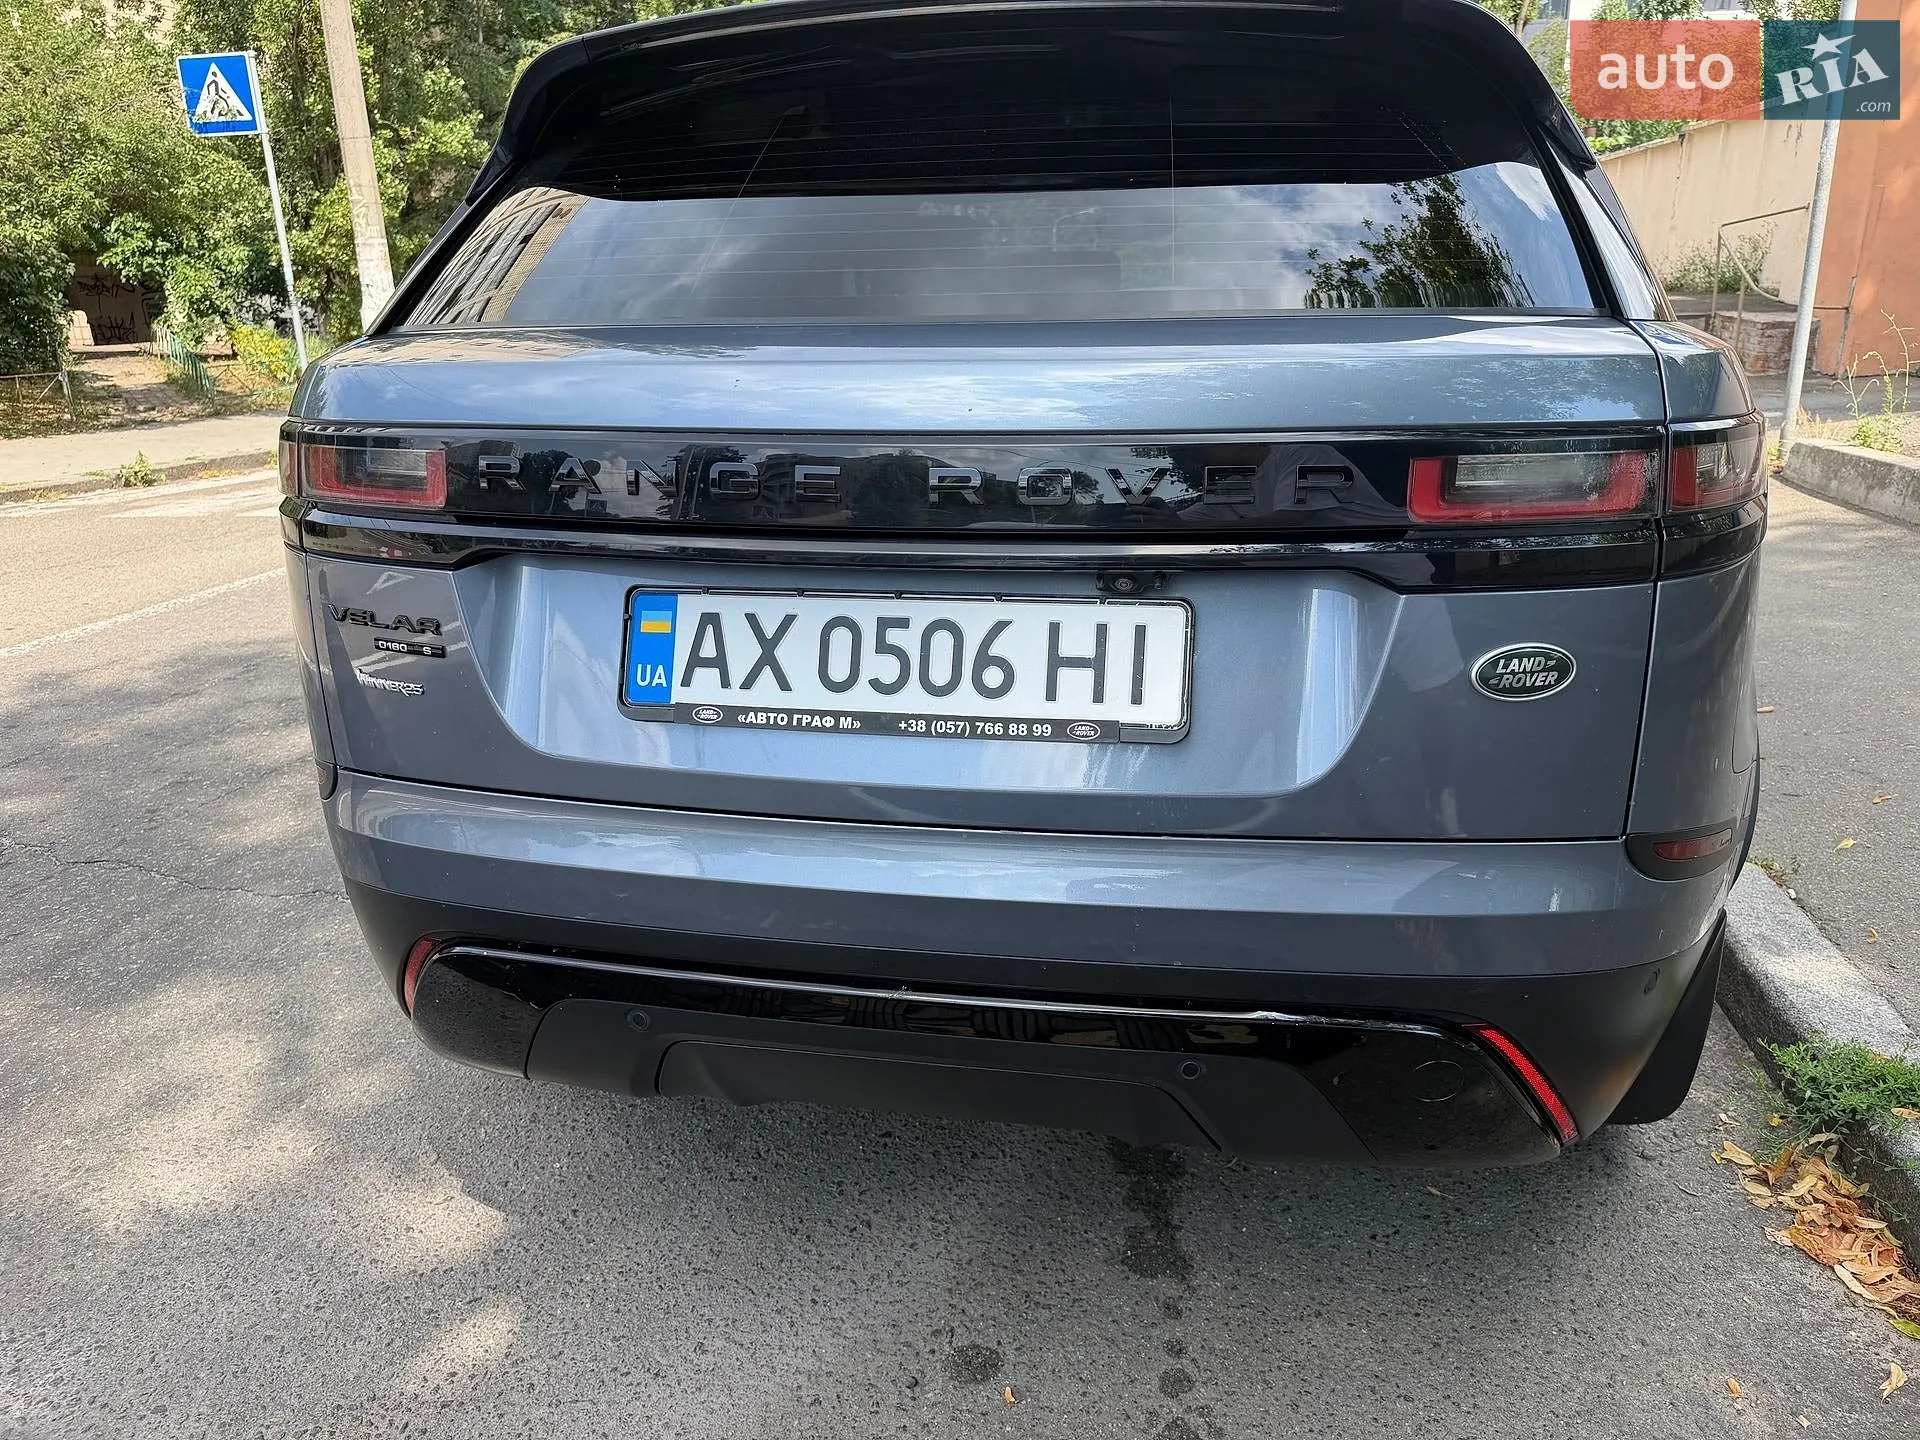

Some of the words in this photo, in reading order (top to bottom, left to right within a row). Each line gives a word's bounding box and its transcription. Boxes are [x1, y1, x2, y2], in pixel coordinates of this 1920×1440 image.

[478, 455, 842, 503] RANGE
[928, 464, 1355, 506] ROVER
[328, 603, 442, 636] VELAR
[422, 646, 432, 655] S
[680, 612, 798, 692] AX
[817, 615, 1015, 700] 0506
[1045, 620, 1147, 705] HI
[1496, 656, 1546, 674] LAND
[636, 663, 668, 688] UA
[1500, 671, 1559, 688] ROVER
[792, 714, 835, 728] ГРАФ
[899, 719, 926, 732] +38
[931, 720, 970, 737] (057)
[975, 722, 1003, 735] 766
[1008, 723, 1028, 736] 88
[1032, 724, 1052, 737] 99
